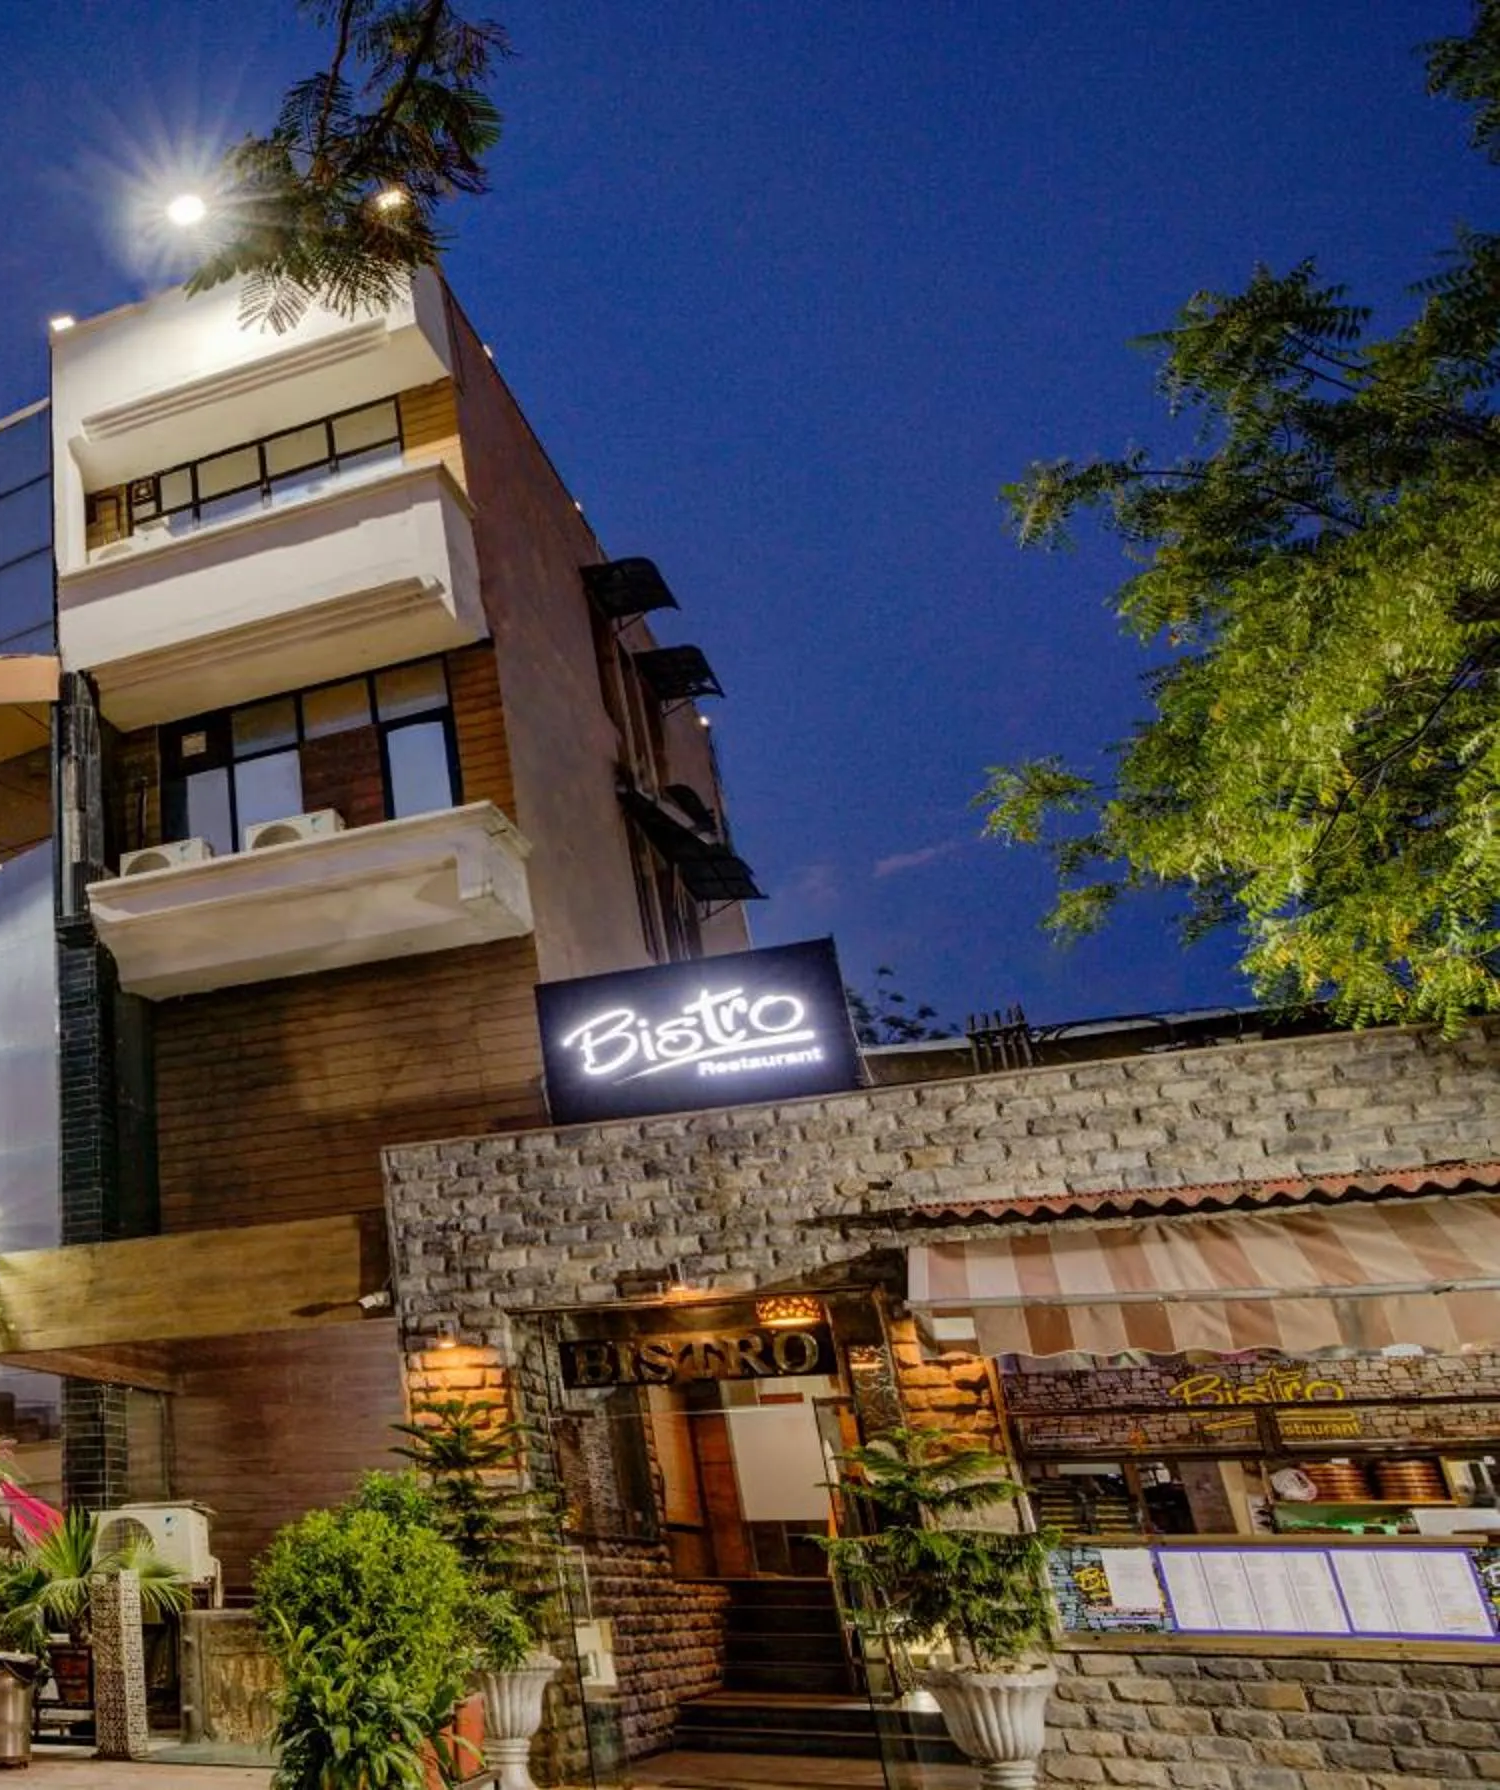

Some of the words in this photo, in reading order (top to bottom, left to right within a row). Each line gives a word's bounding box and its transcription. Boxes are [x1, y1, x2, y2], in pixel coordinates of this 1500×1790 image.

[561, 987, 805, 1075] Bistro
[698, 1047, 823, 1077] Restaurant
[573, 1331, 819, 1385] BISTRO
[1282, 1420, 1362, 1437] staurant
